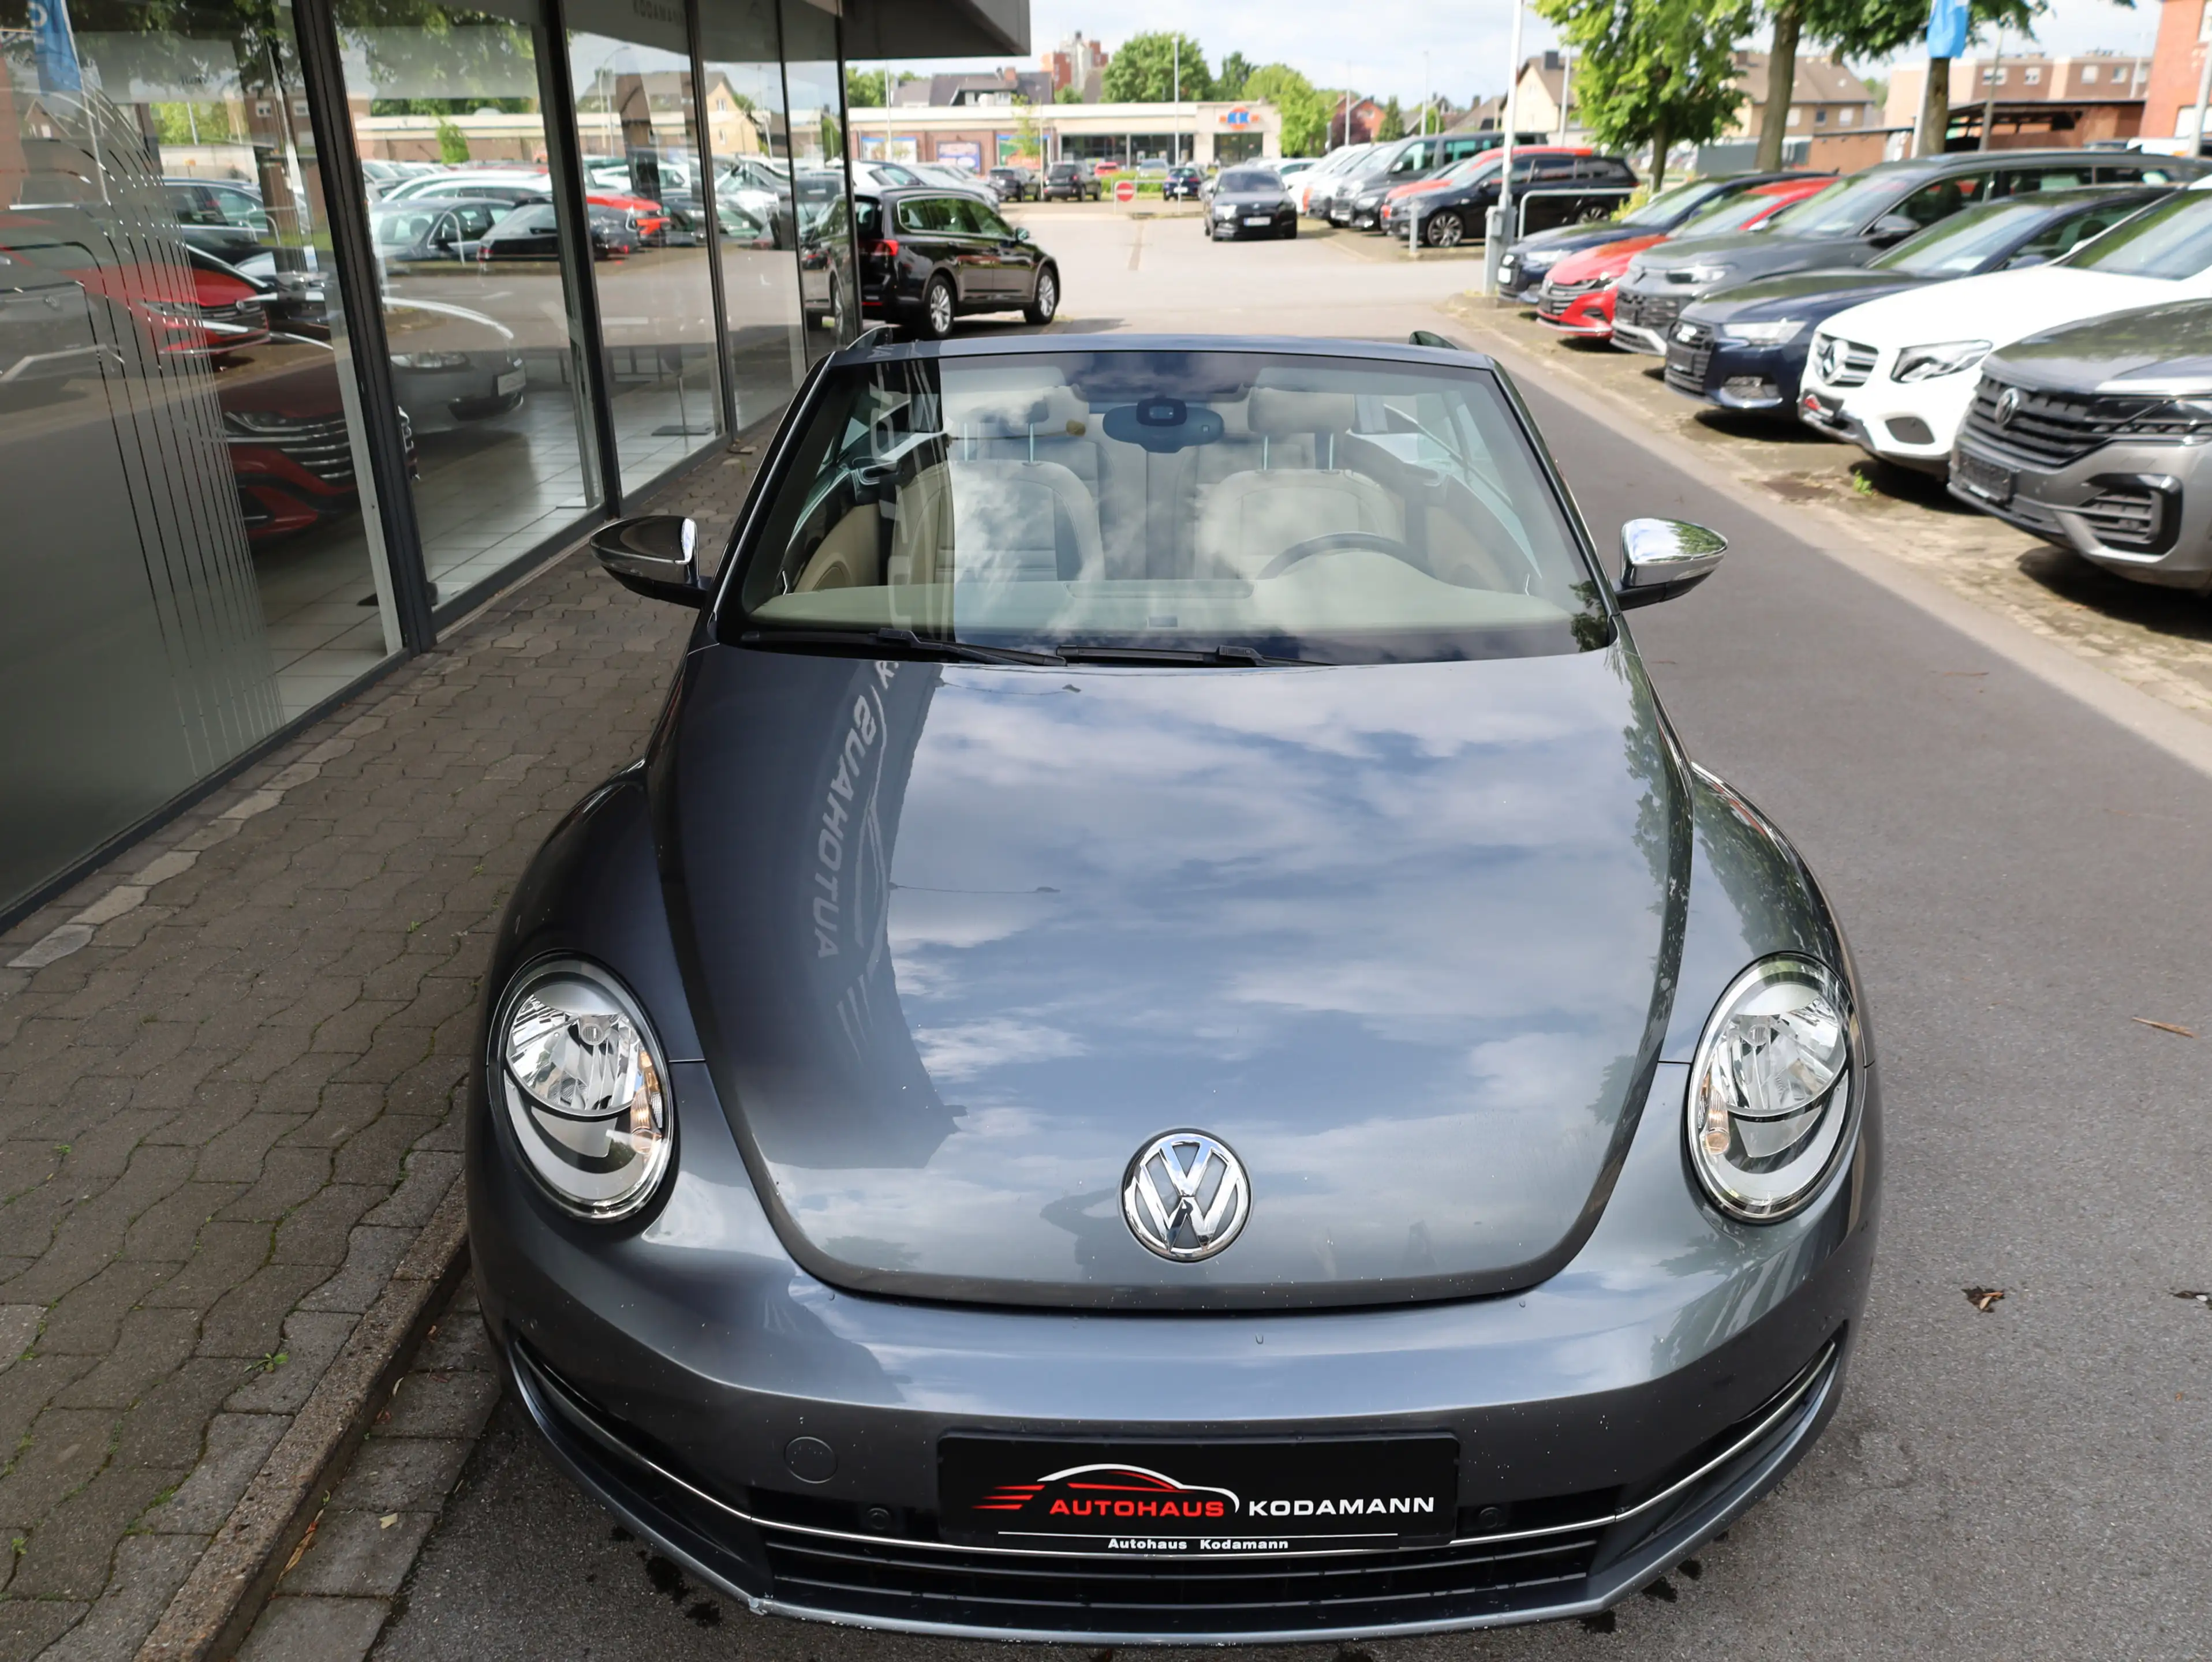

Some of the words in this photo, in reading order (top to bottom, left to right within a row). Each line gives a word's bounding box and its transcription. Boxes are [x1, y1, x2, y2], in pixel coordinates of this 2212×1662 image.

[1049, 1499, 1224, 1517] AUTOHAUS
[1249, 1497, 1434, 1517] KODAMANN
[1108, 1538, 1187, 1549] Autohaus
[1200, 1539, 1288, 1549] Kodamann
